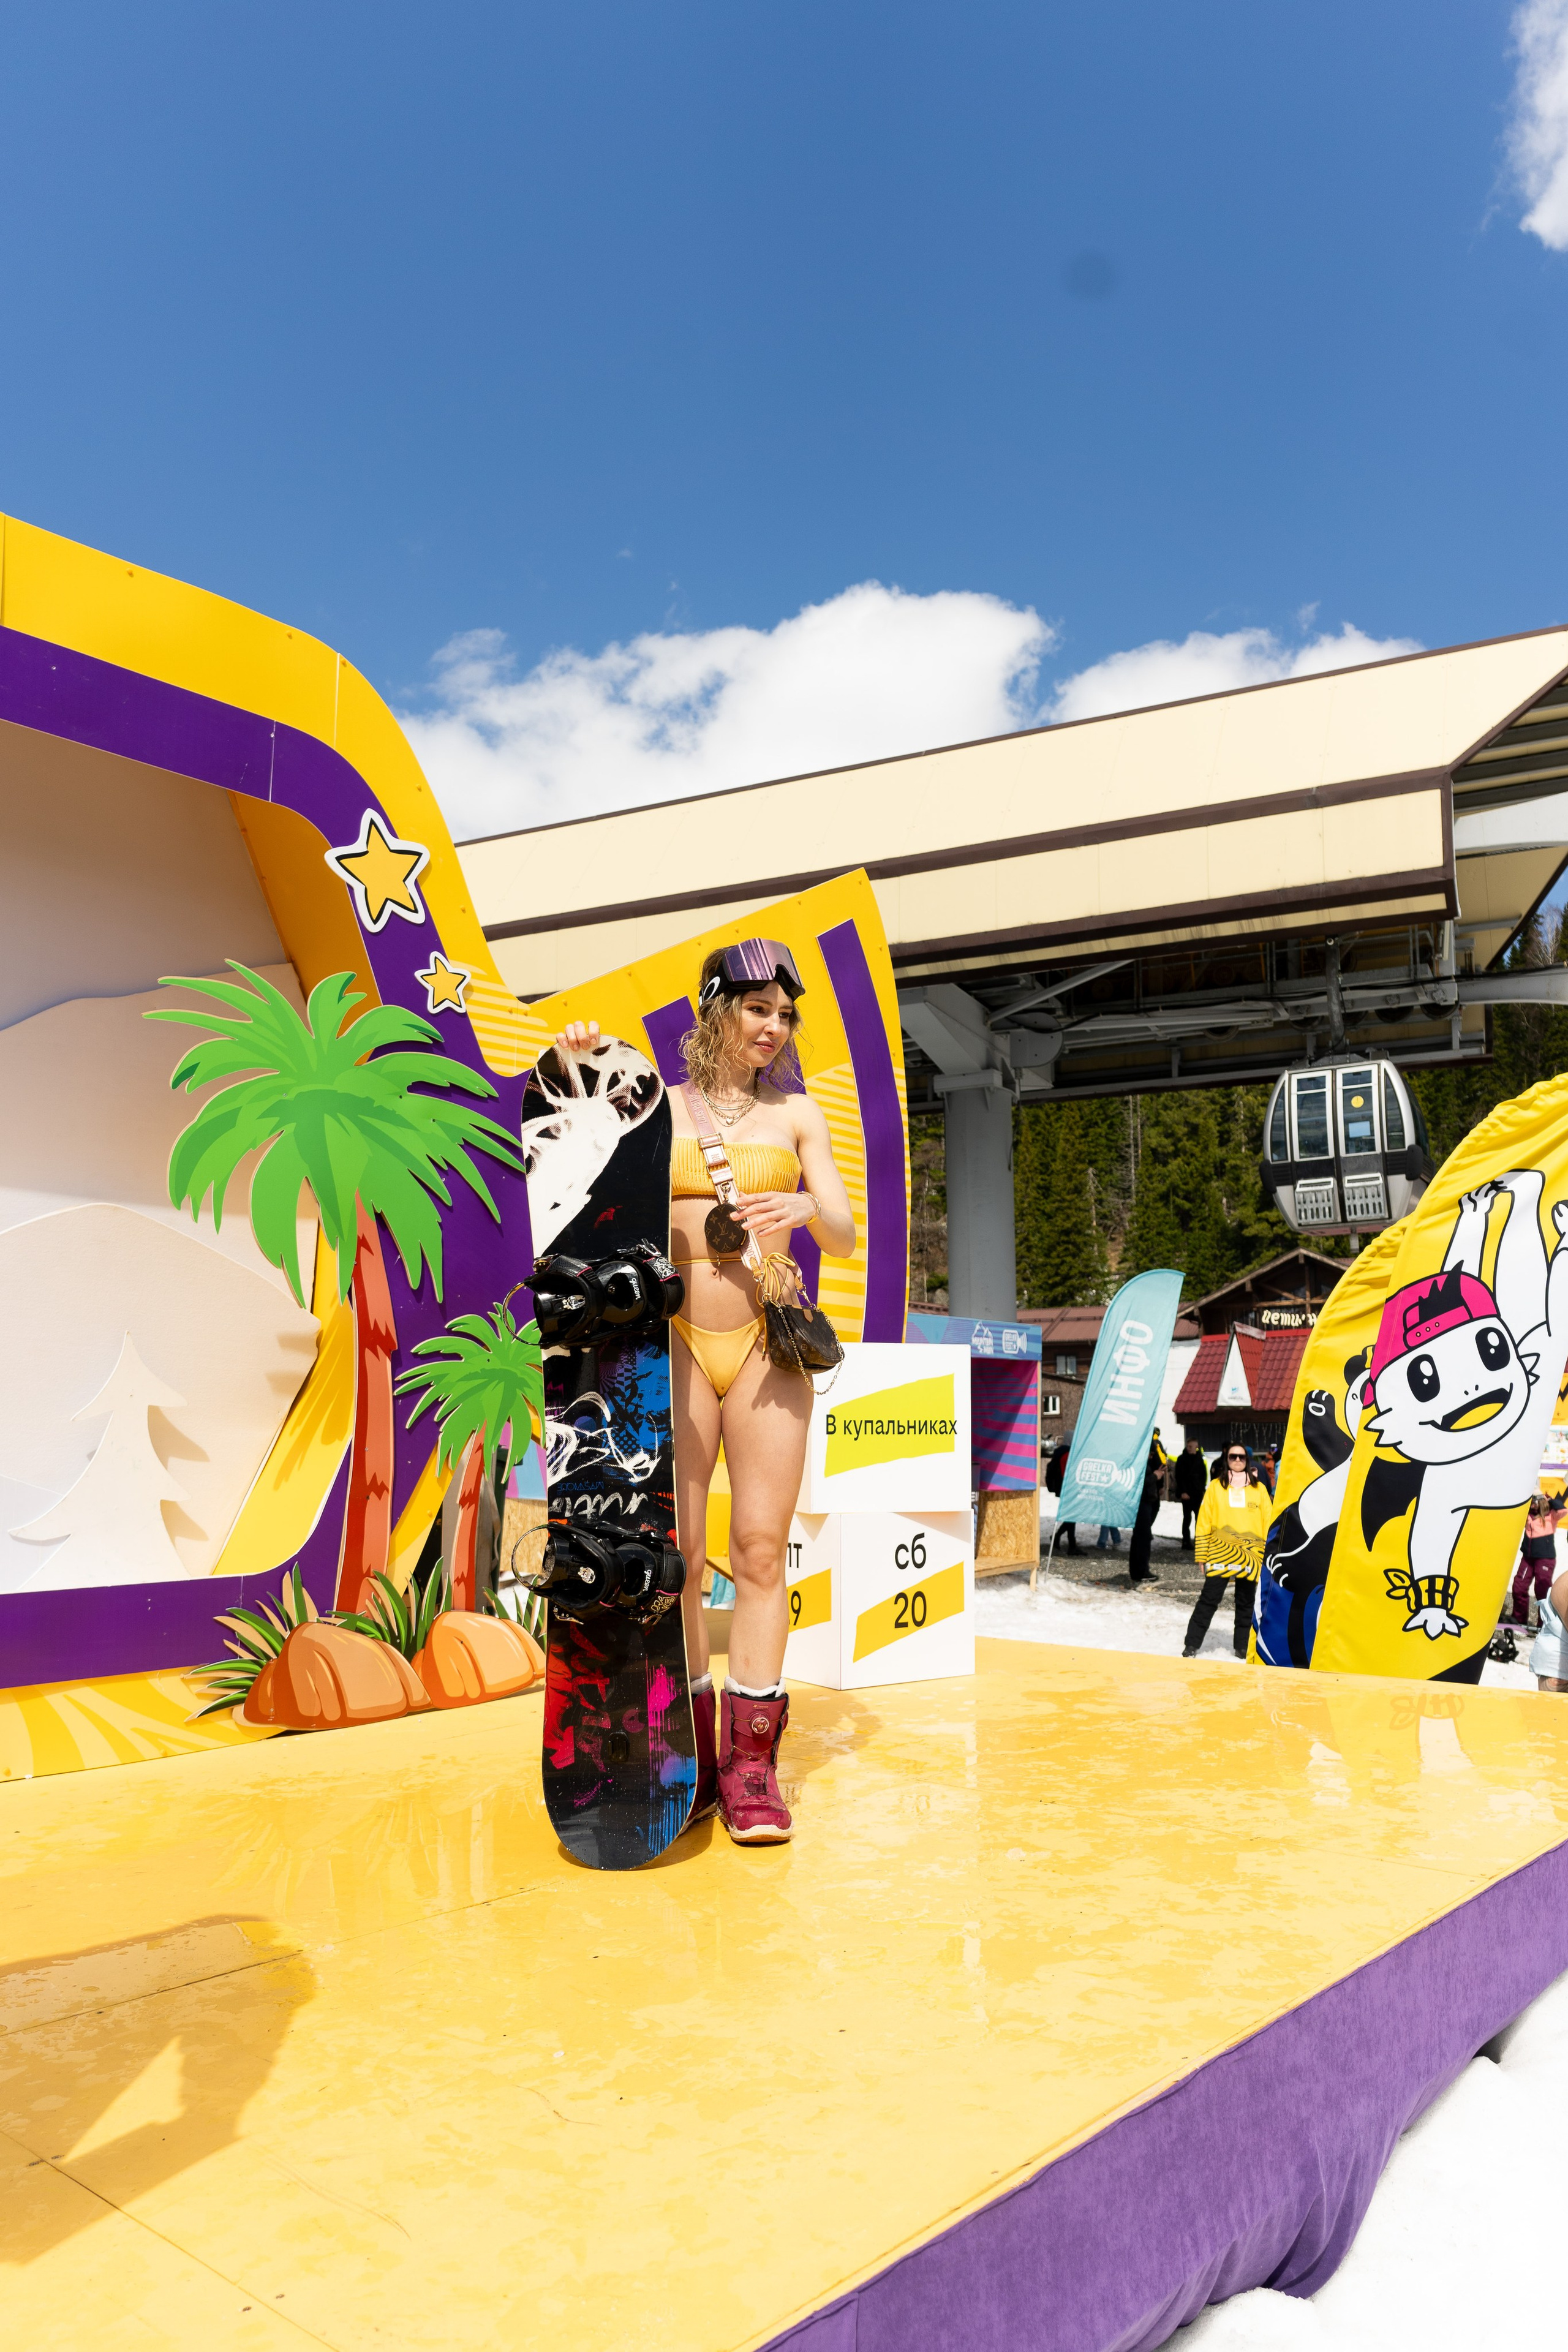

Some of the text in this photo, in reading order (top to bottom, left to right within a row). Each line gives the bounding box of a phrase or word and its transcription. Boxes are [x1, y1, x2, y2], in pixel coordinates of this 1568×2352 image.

[1099, 1319, 1154, 1426] ИНФО
[826, 1414, 957, 1441] В купальниках
[1080, 1471, 1101, 1482] FEST
[1083, 1461, 1112, 1474] GRELKA
[894, 1532, 927, 1570] сб
[643, 1569, 652, 1591] queen
[787, 1589, 802, 1626] 9
[894, 1591, 927, 1629] 20
